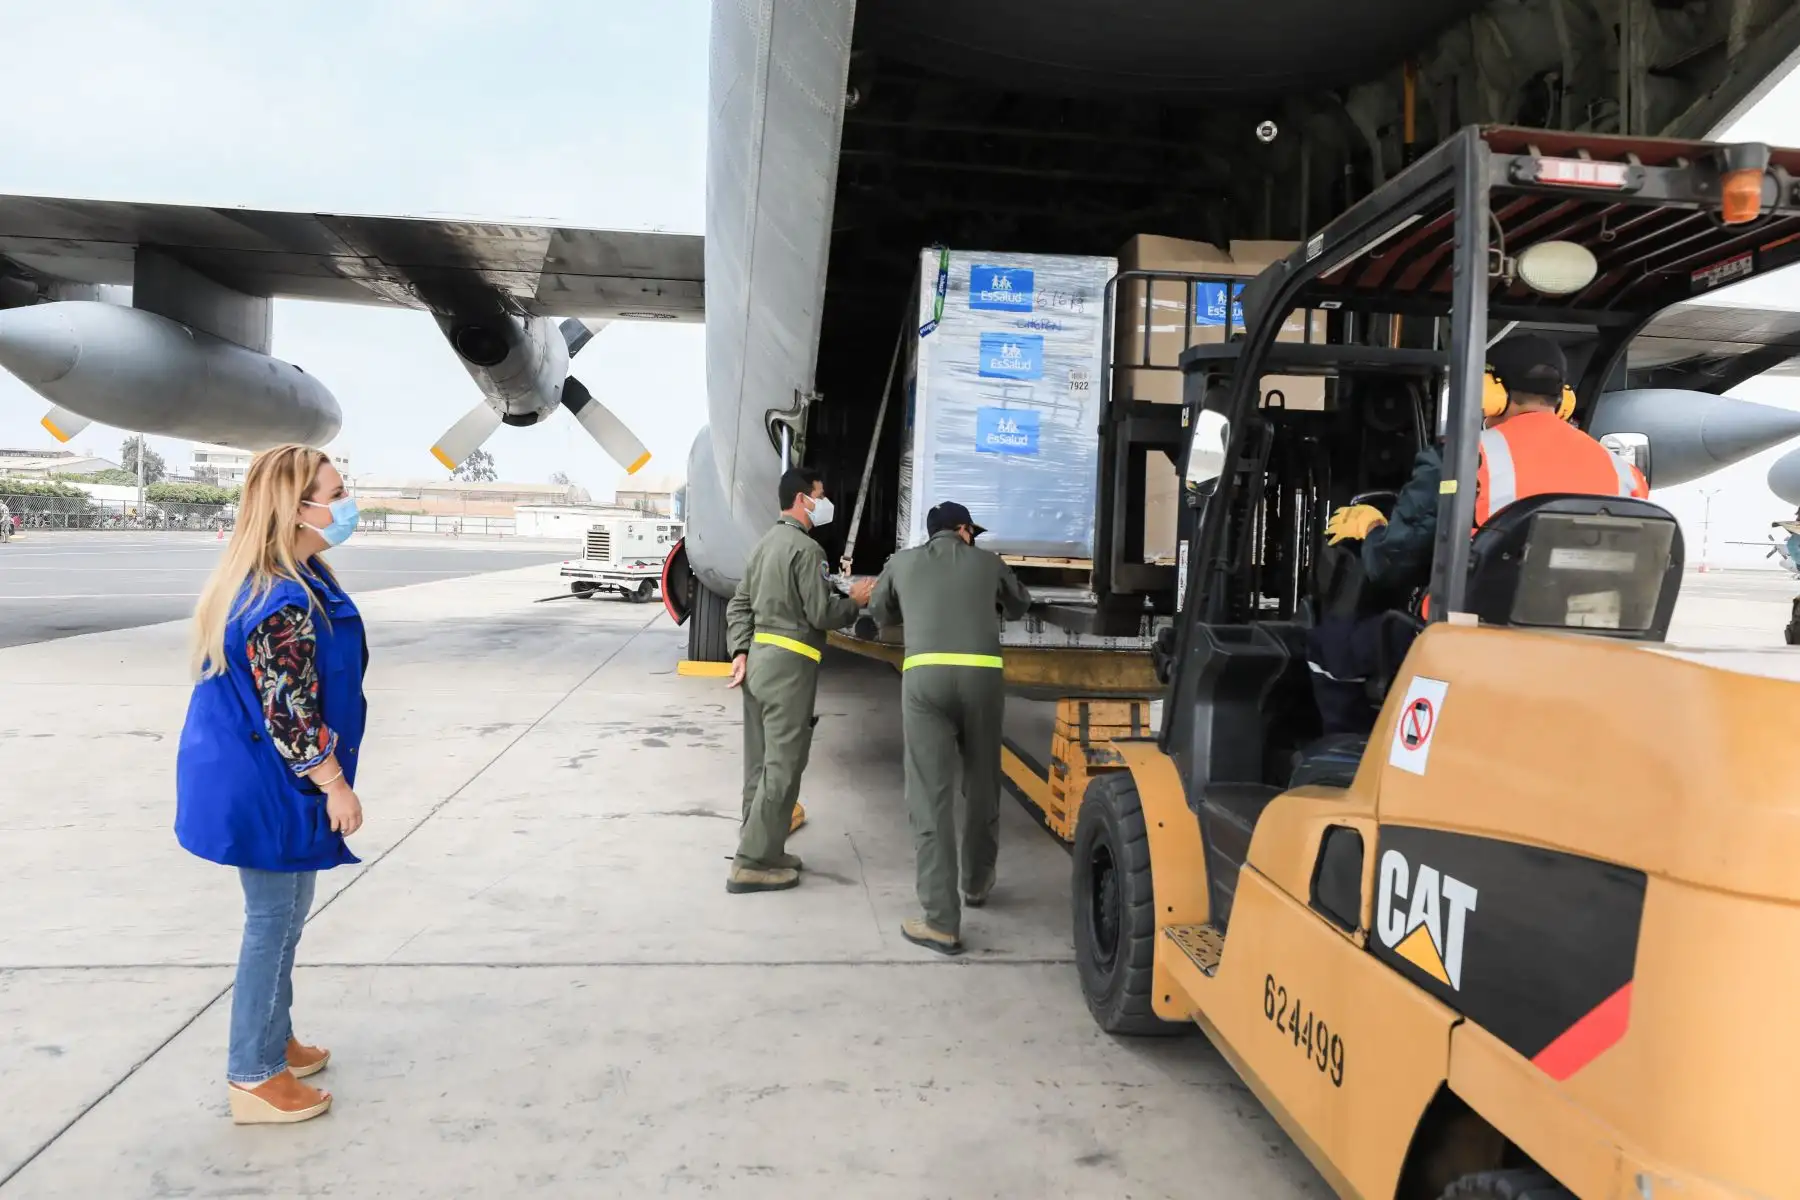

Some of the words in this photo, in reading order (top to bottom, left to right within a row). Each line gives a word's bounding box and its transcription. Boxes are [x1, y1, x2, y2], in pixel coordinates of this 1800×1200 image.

[981, 291, 1023, 303] EsSalud
[990, 358, 1032, 371] EsSalud
[1070, 381, 1089, 391] 7922
[986, 432, 1029, 446] EsSalud
[1377, 849, 1479, 991] CAT
[1264, 974, 1345, 1088] 624499
